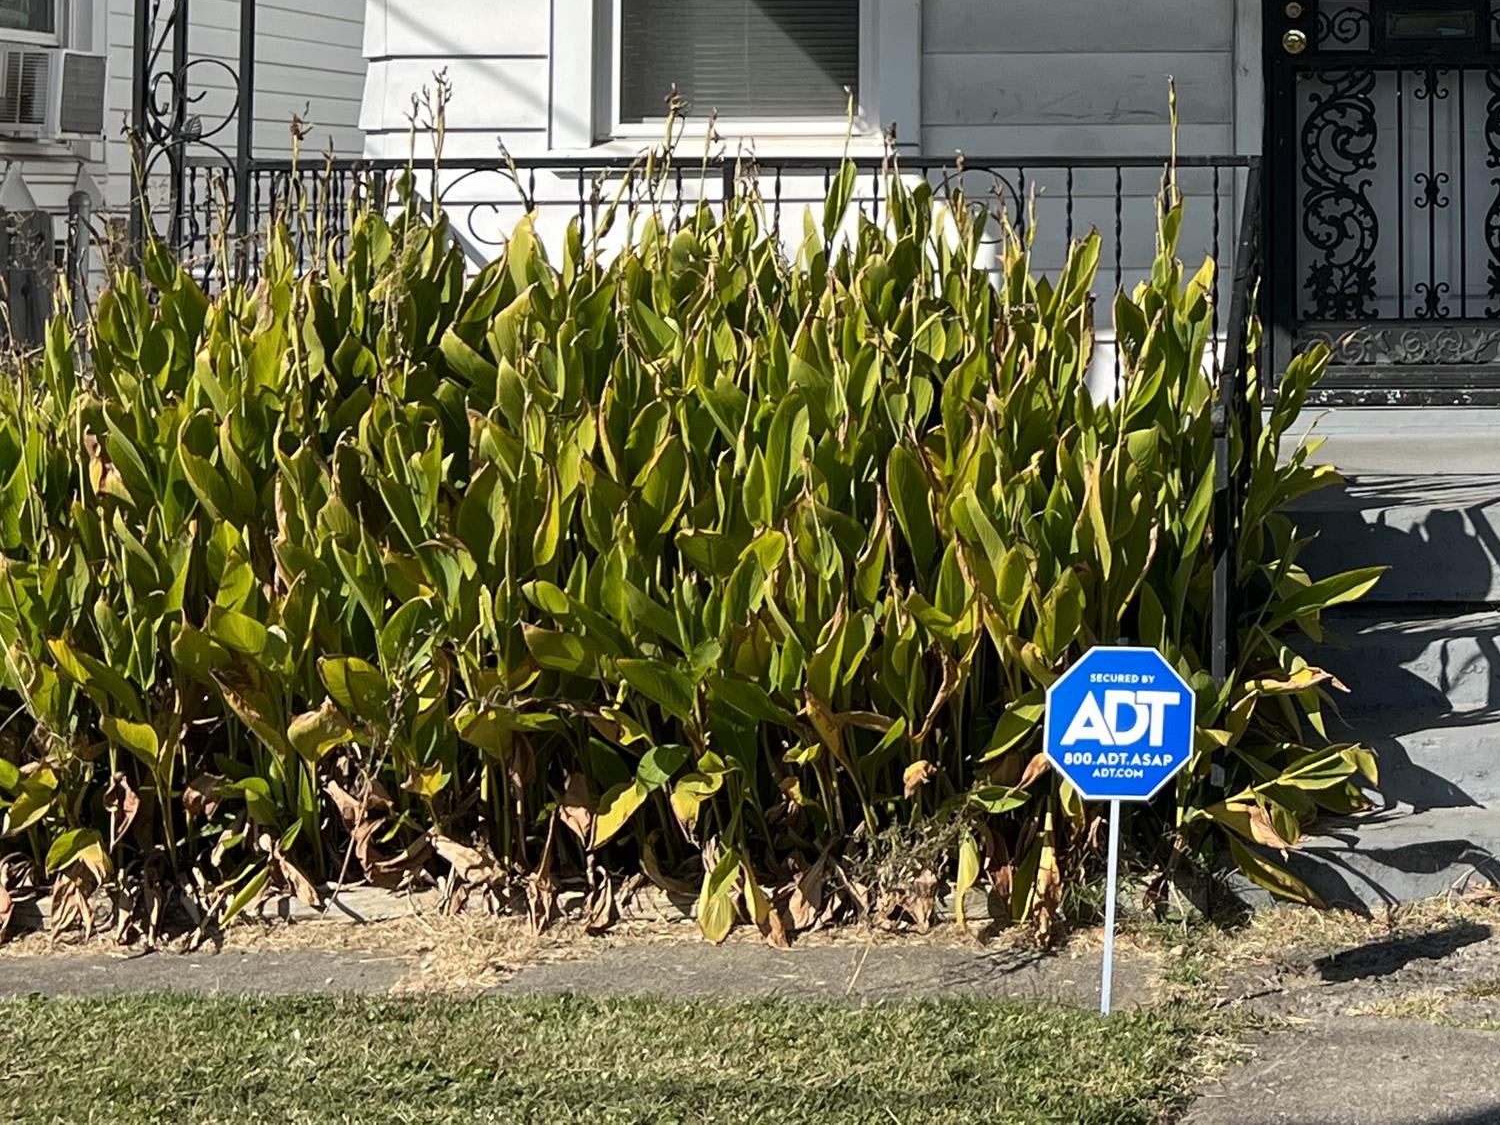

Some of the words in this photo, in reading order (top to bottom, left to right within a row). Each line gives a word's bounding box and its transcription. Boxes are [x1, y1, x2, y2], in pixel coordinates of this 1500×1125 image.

[1089, 673, 1139, 683] SECURED
[1141, 674, 1155, 684] BY
[1059, 689, 1181, 747] ADT
[1063, 752, 1174, 767] 800.ADT.ASAP
[1092, 768, 1144, 779] ADT.COM
